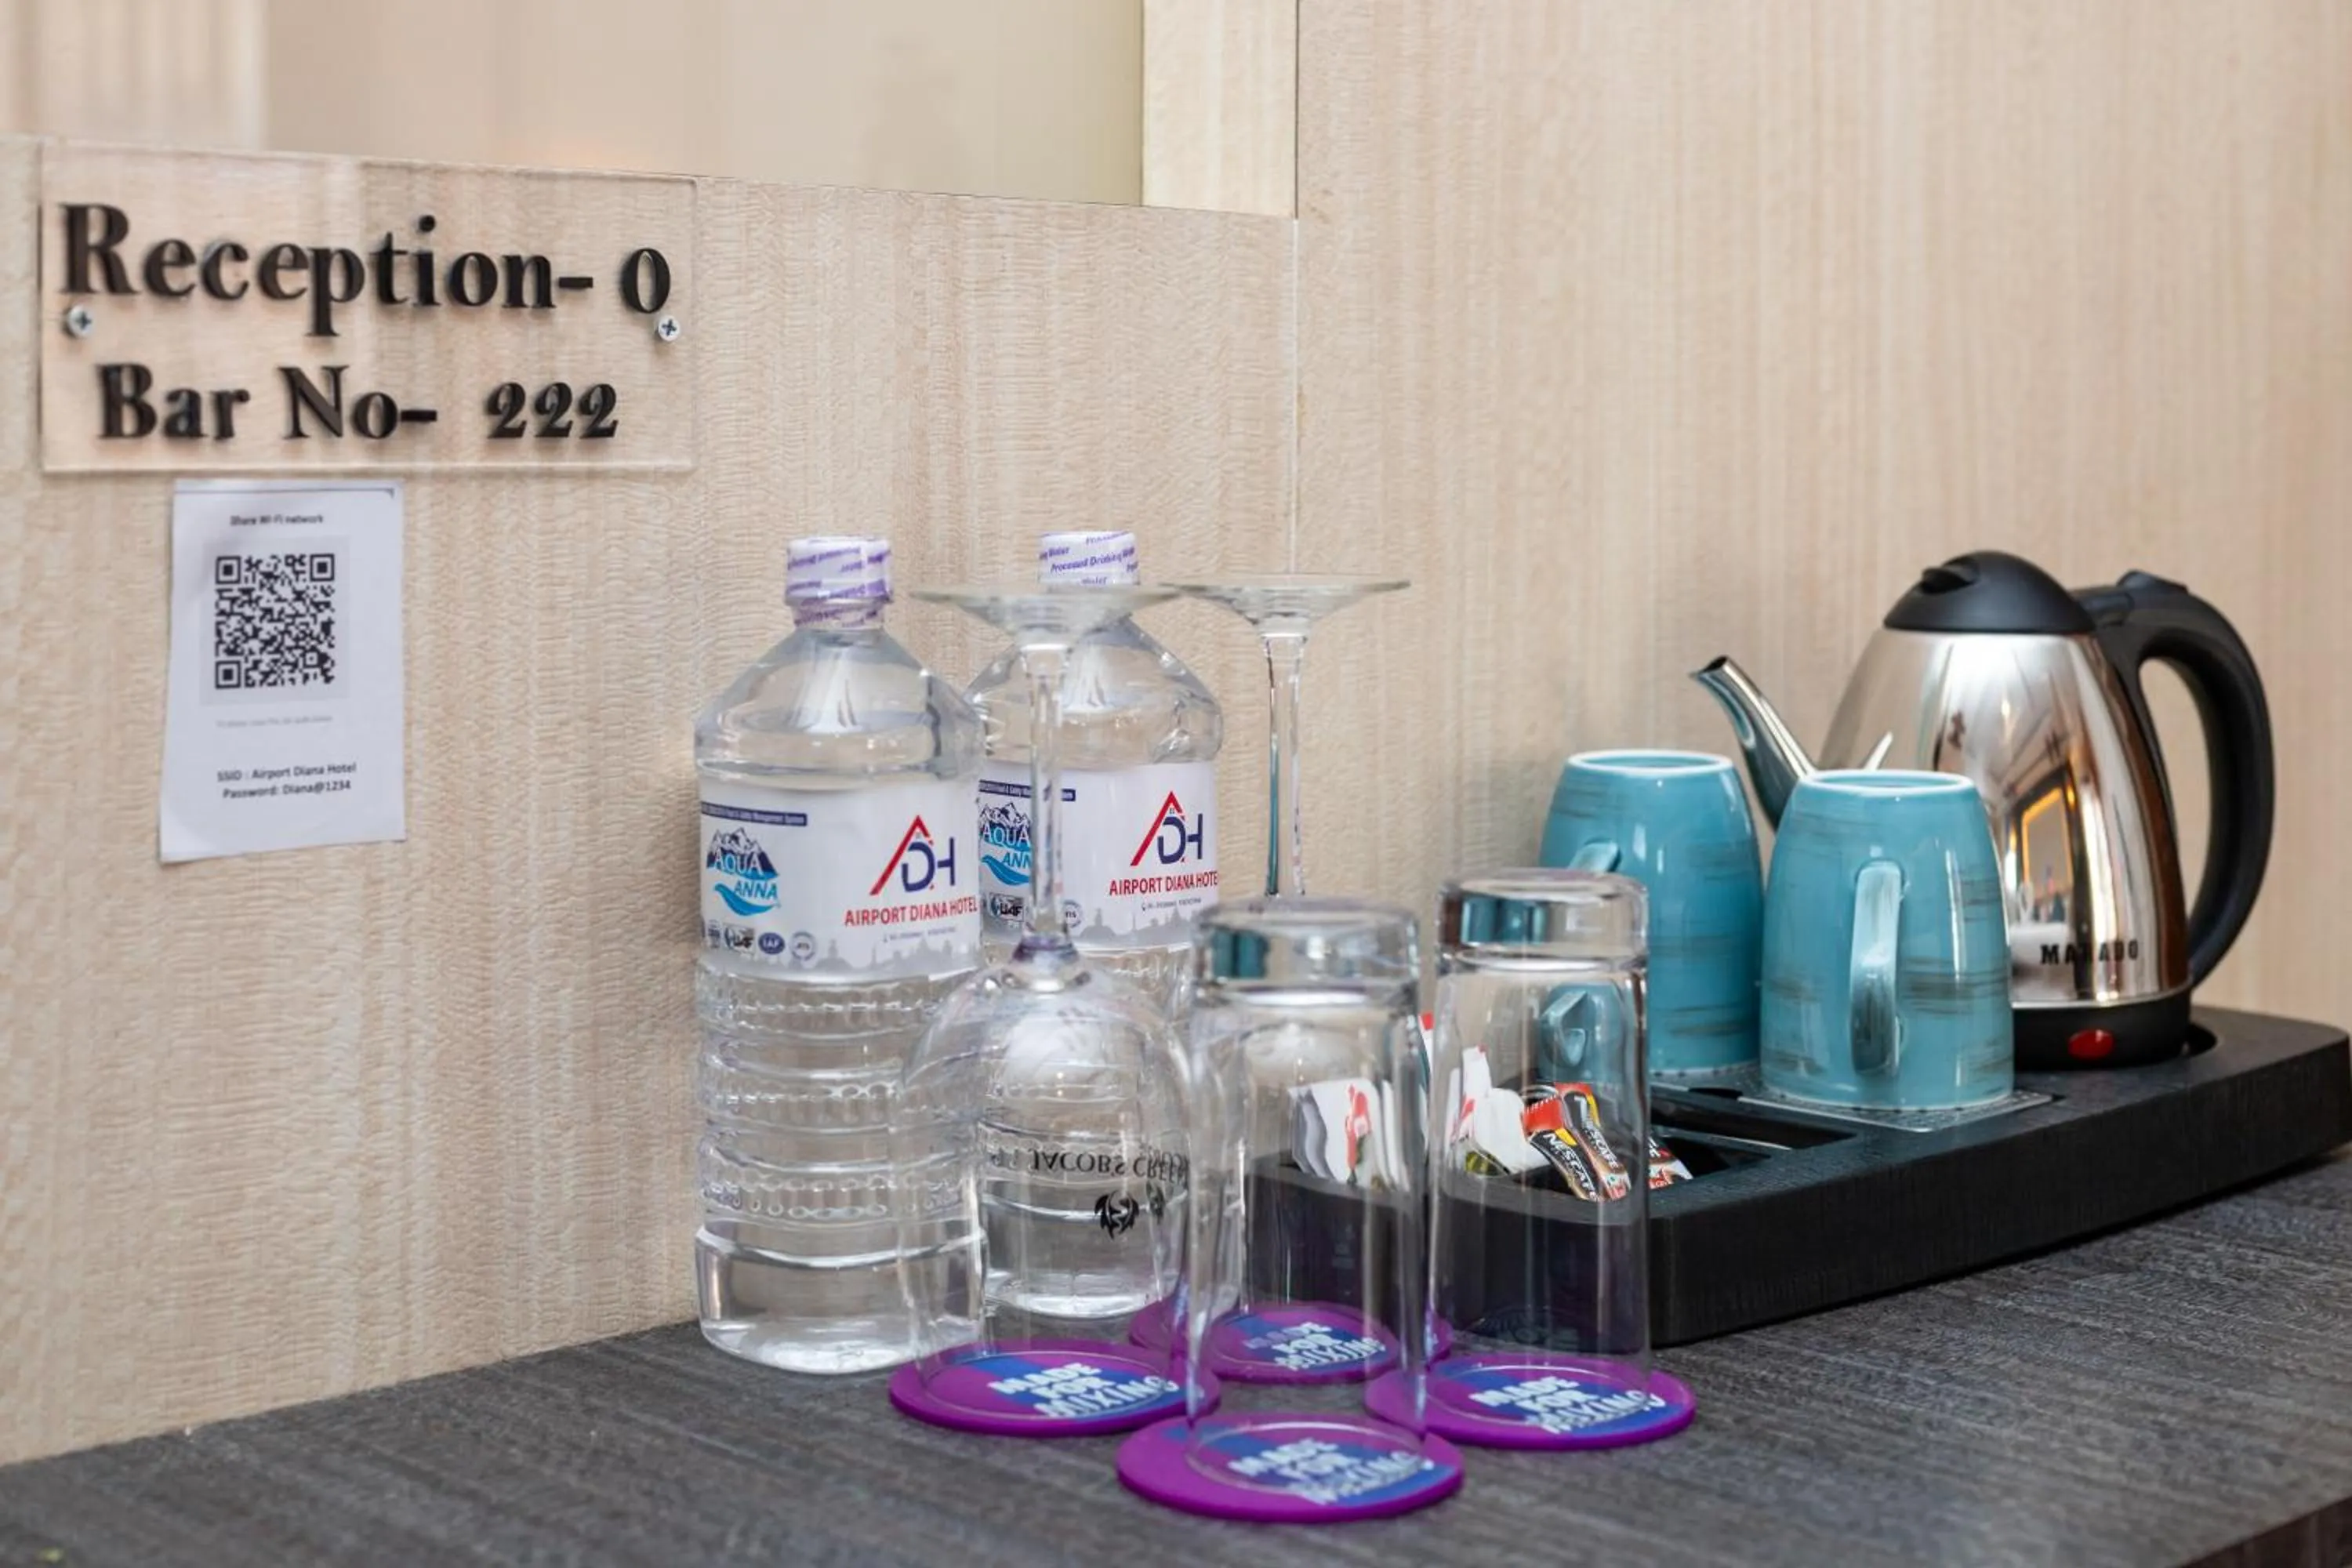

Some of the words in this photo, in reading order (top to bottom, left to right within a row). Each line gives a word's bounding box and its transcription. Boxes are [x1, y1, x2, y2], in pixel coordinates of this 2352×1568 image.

[60, 202, 593, 337] Reception-
[620, 246, 672, 314] 0
[96, 362, 250, 441] Bar
[279, 365, 438, 441] No-
[487, 381, 620, 441] 222
[252, 768, 291, 781] Airport
[293, 766, 325, 777] Diana
[327, 762, 357, 774] Hotel
[282, 780, 351, 795] Diana@1234
[982, 821, 1032, 848] AQUA
[714, 847, 764, 877] AQUA
[735, 879, 778, 901] ANNA
[1109, 877, 1162, 896] AIRPORT
[1165, 875, 1195, 892] DIANA
[1196, 871, 1218, 887] HOTE
[844, 906, 907, 927] AIRPORT
[909, 902, 948, 922] DIANA
[949, 896, 978, 916] HOTEL
[2041, 939, 2139, 965] MAADO
[1243, 1322, 1332, 1349] MADE
[1274, 1338, 1386, 1371] MIXING
[986, 1362, 1102, 1395] MADE
[1033, 1375, 1180, 1417] MIXING
